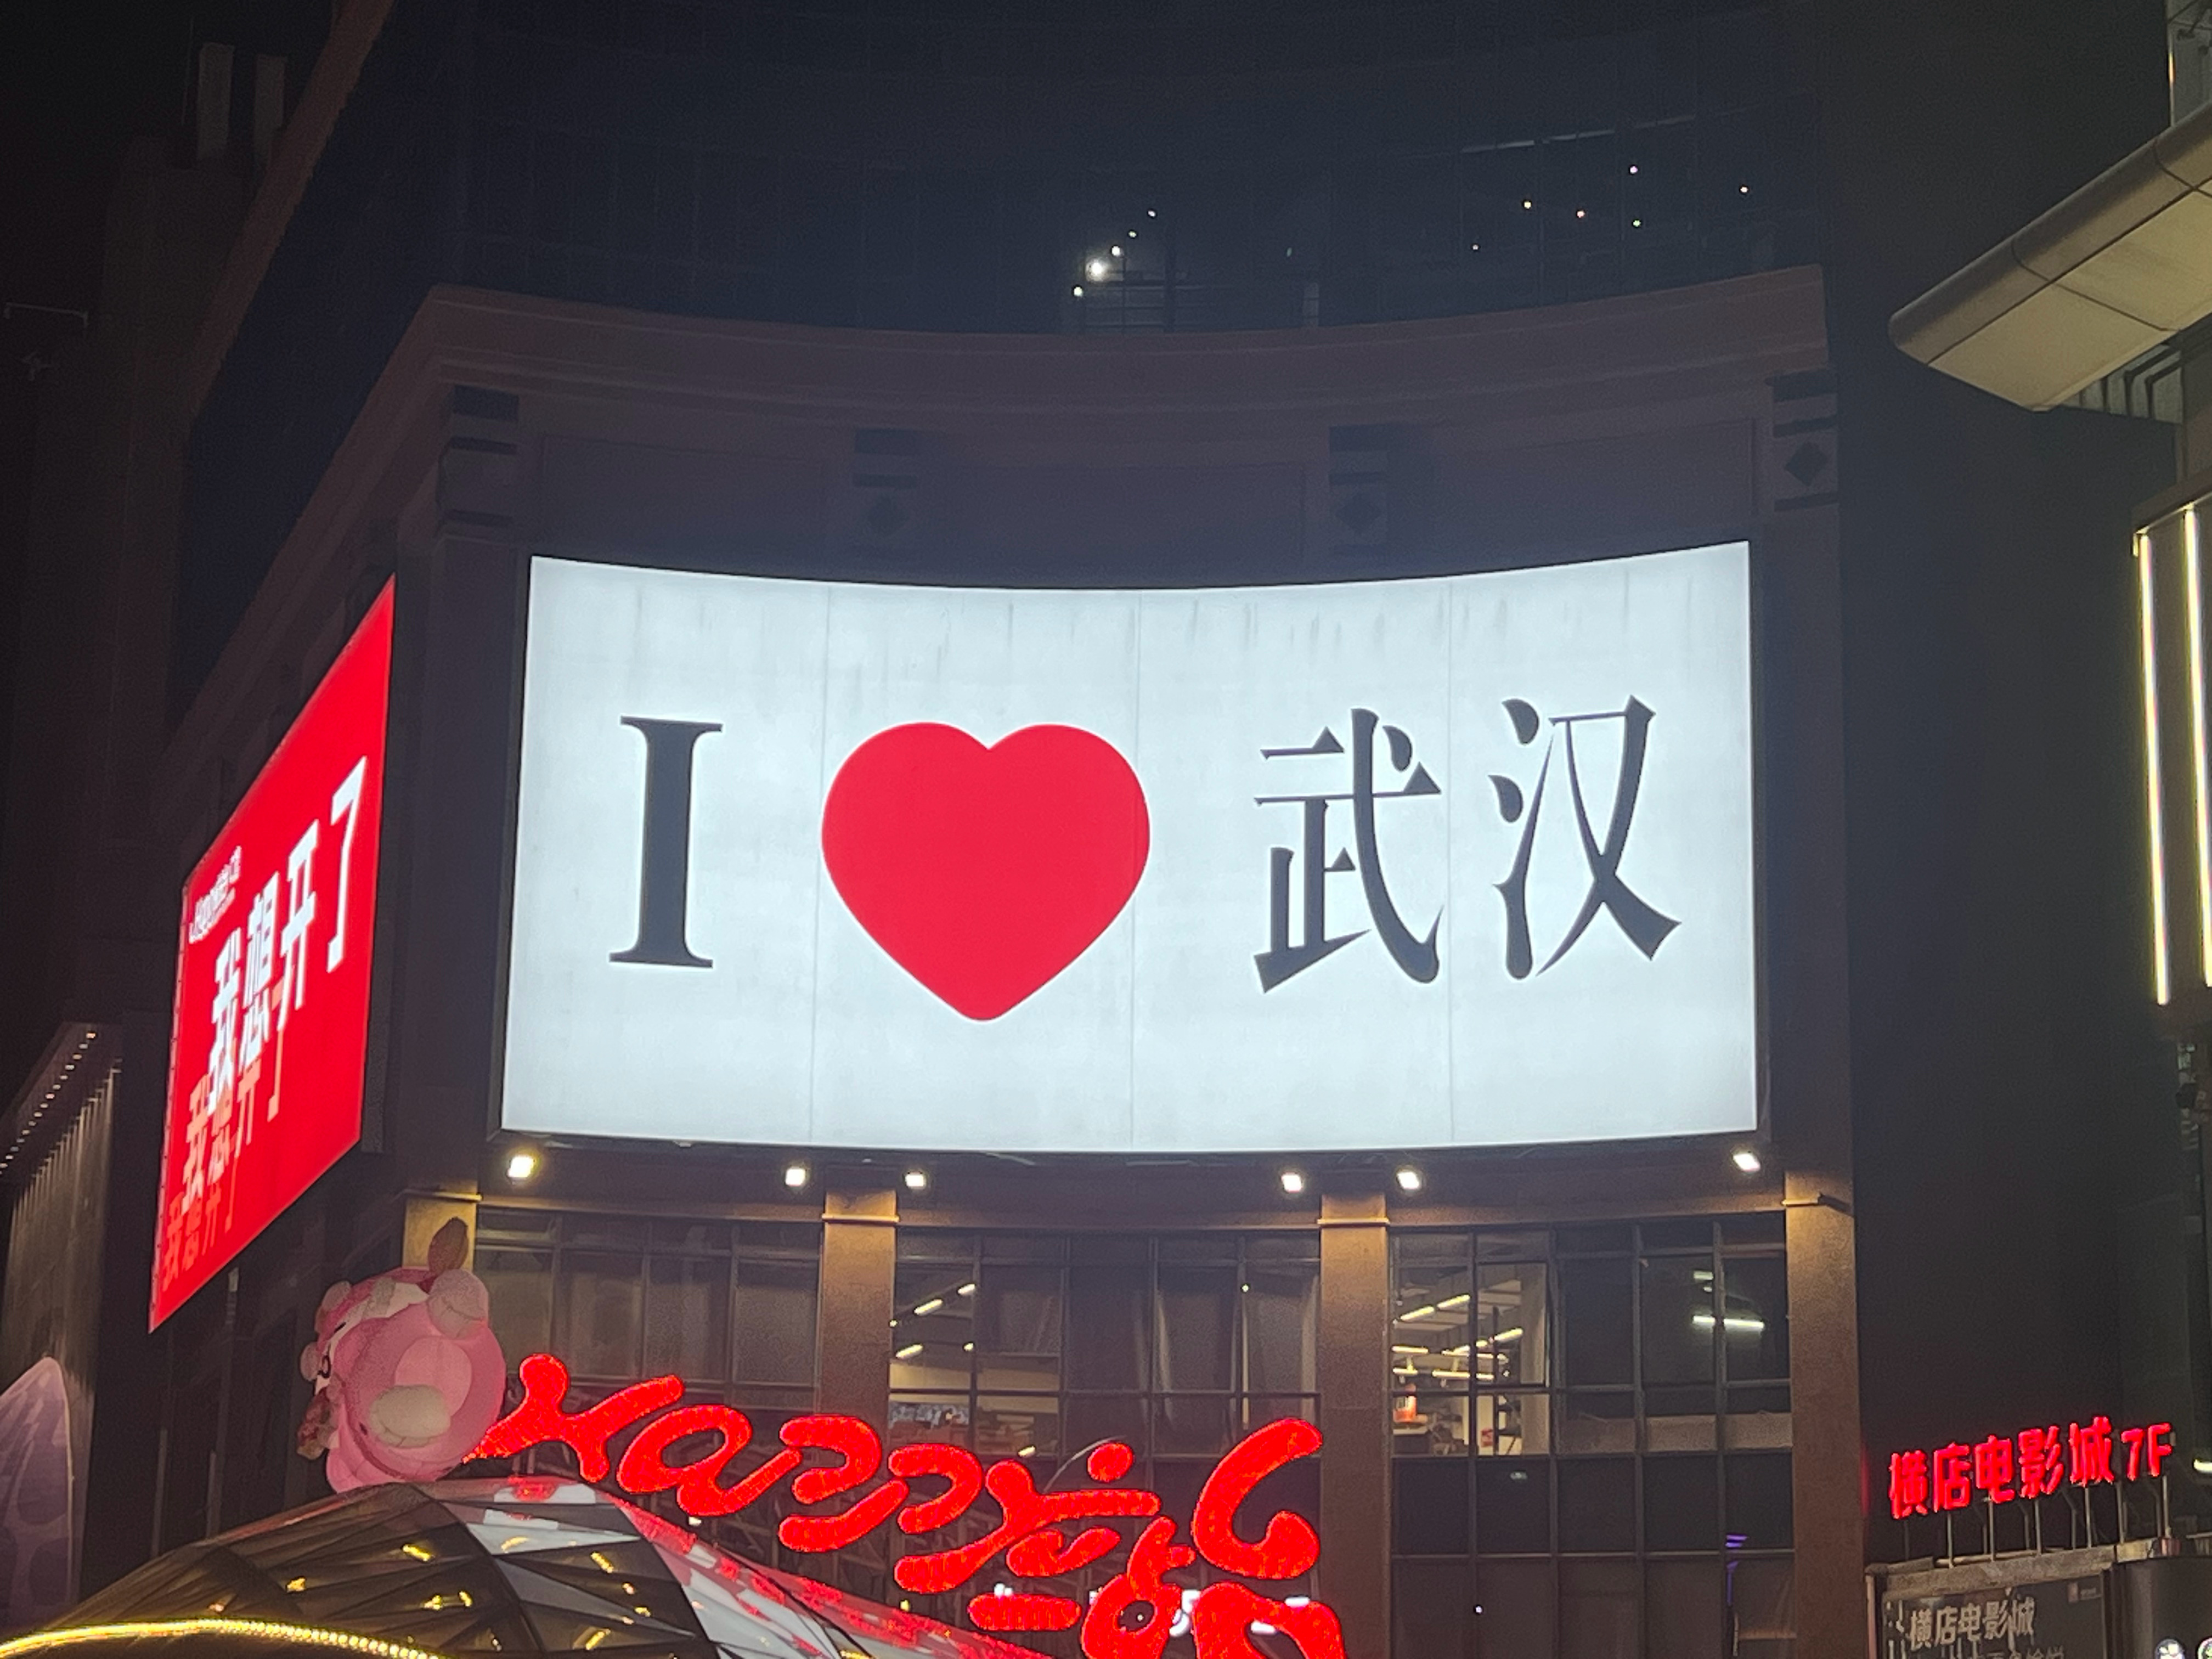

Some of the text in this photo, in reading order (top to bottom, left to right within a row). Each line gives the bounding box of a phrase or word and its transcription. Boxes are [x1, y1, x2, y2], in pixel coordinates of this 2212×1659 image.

[205, 756, 367, 1117] 我想开了
[610, 695, 1681, 994] I 武汉
[1888, 1415, 2172, 1520] 横店电影城 7F
[1906, 1596, 2035, 1651] 横店电影城
